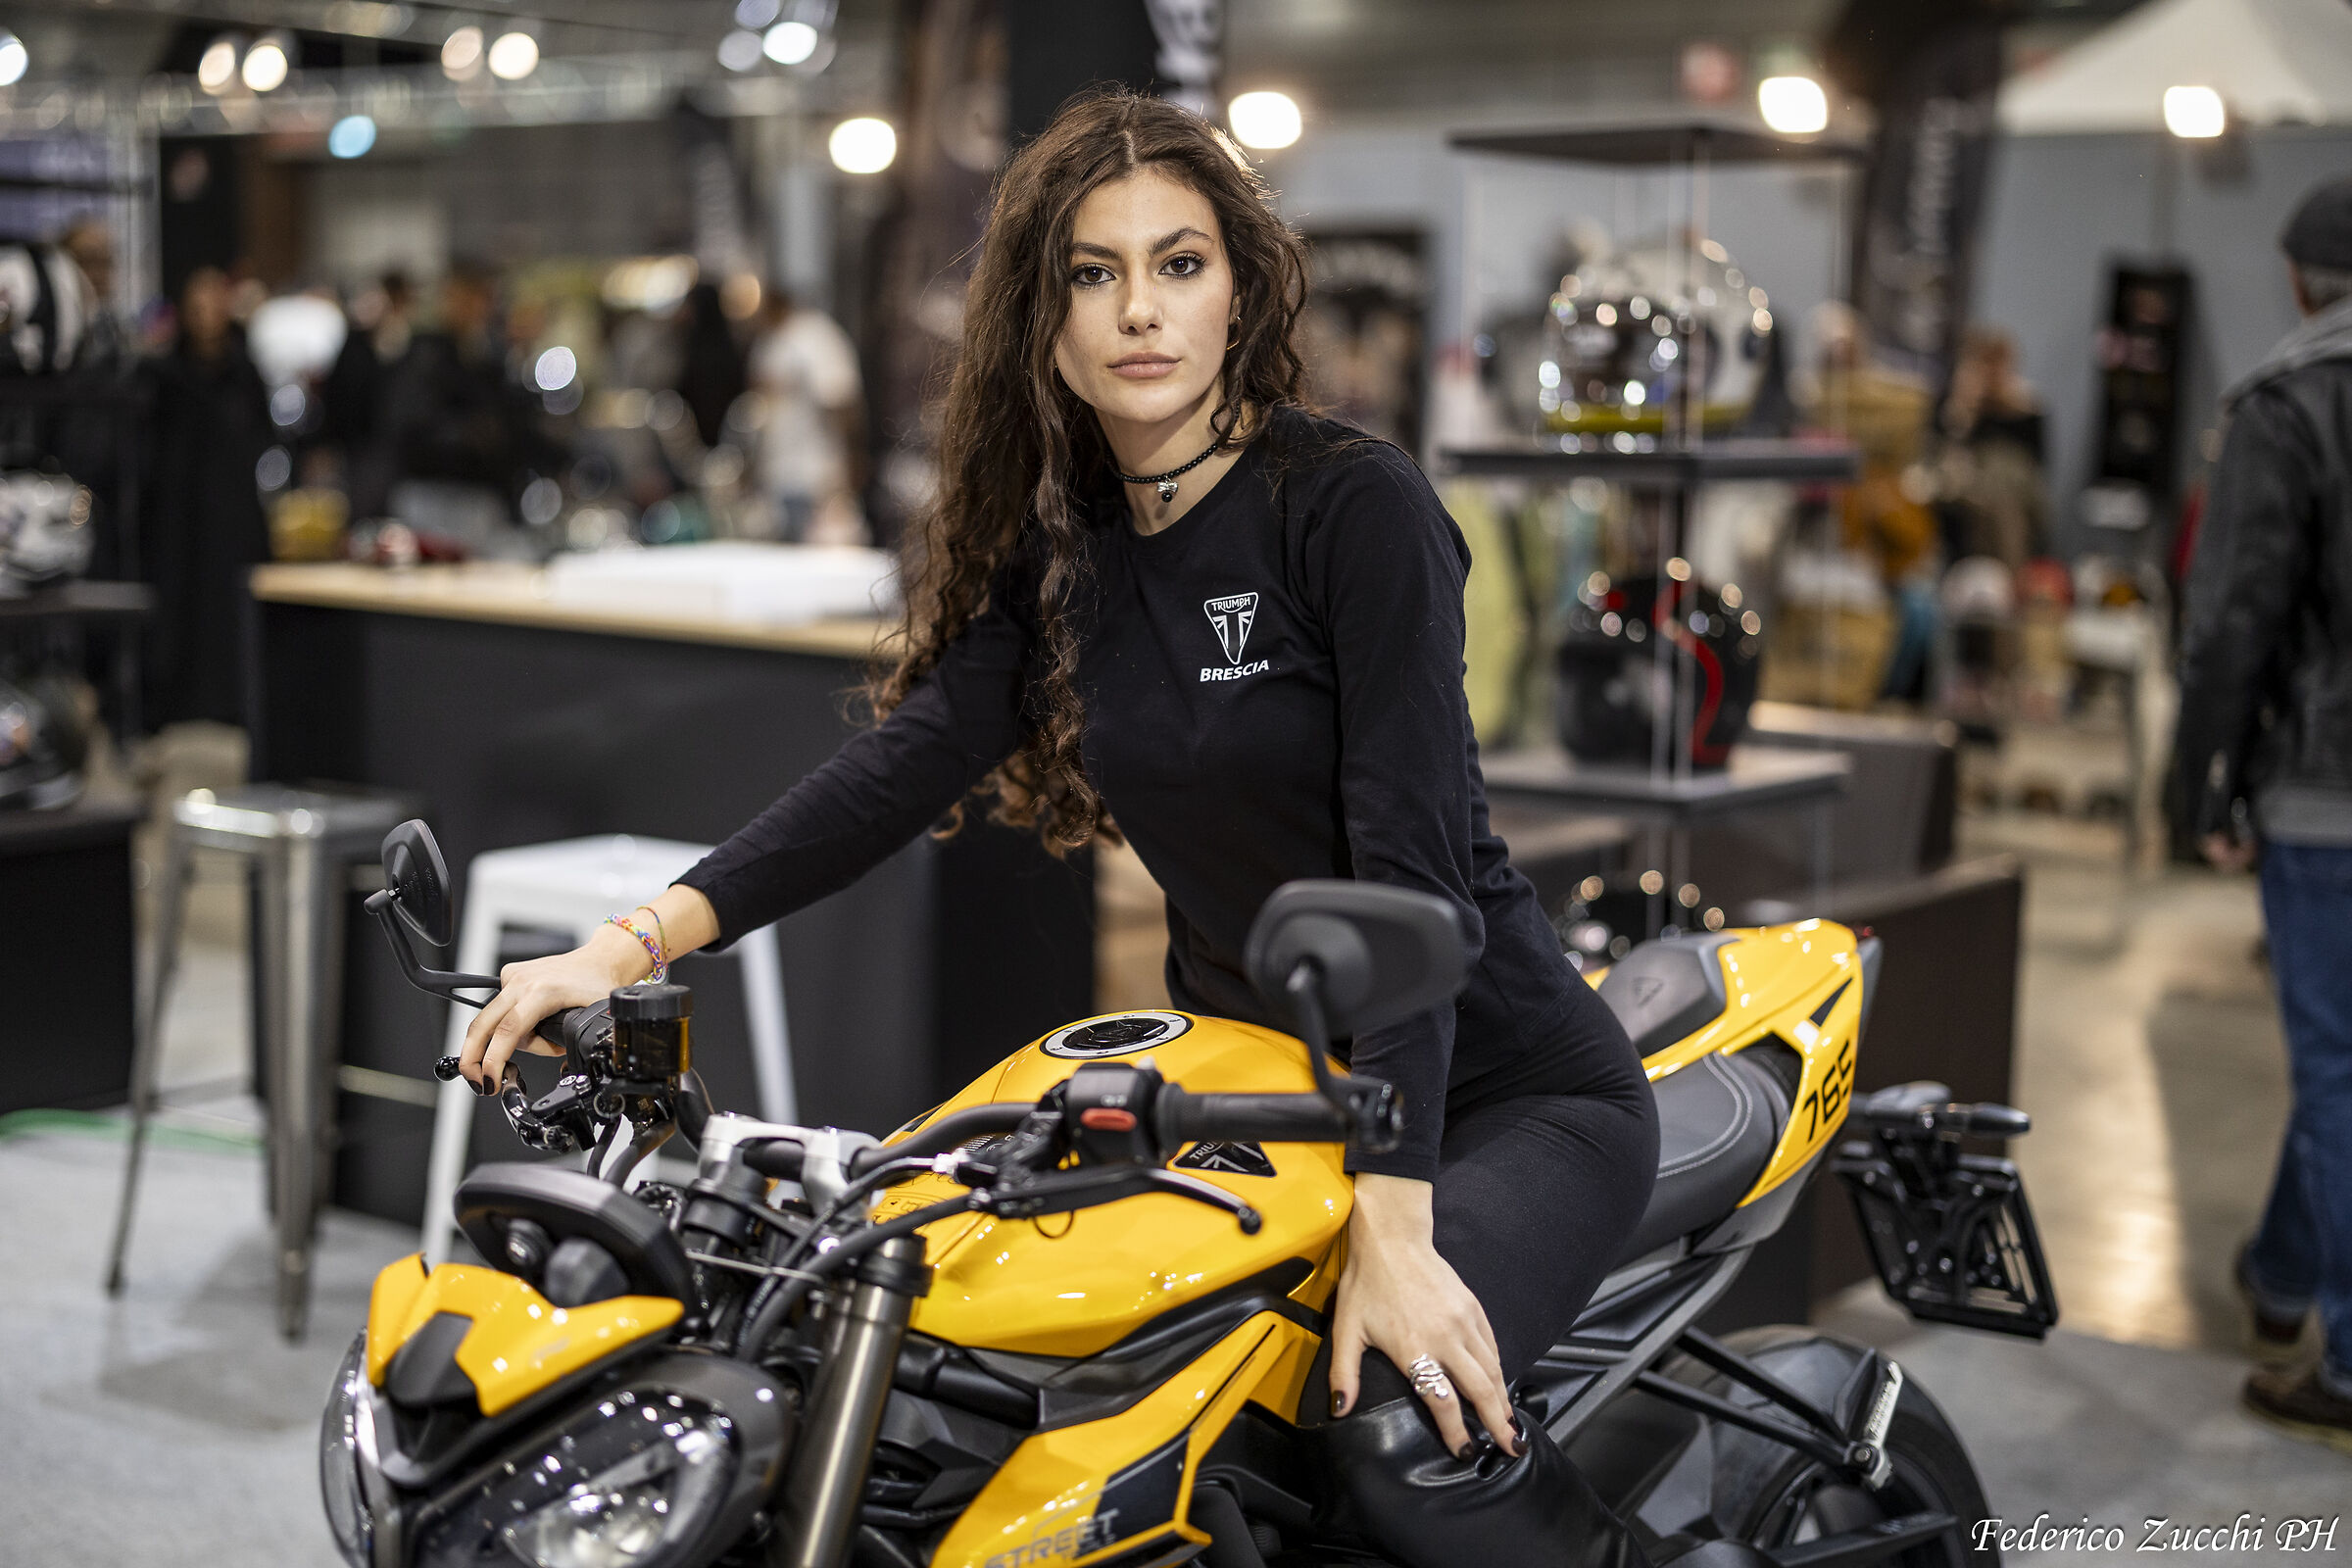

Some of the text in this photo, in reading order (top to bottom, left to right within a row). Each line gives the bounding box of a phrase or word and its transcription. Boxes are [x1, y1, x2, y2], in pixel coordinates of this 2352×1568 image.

[1211, 596, 1250, 612] TRIUMPH
[1200, 660, 1269, 682] BRESCIA
[1802, 1039, 1852, 1144] 765
[1189, 1142, 1218, 1160] TRIU
